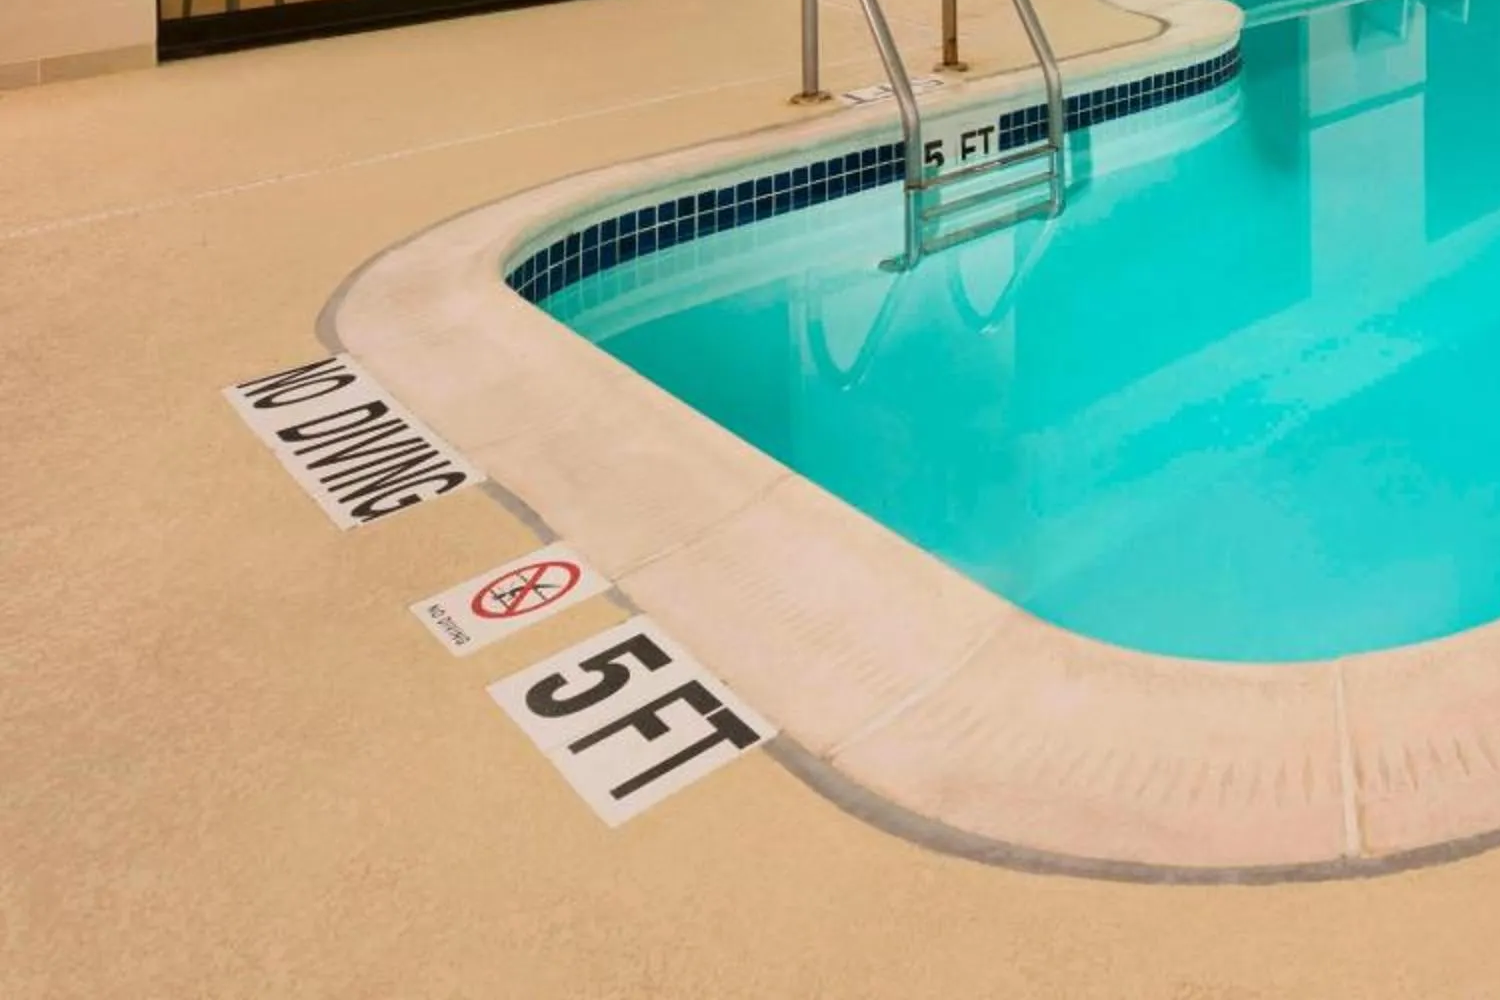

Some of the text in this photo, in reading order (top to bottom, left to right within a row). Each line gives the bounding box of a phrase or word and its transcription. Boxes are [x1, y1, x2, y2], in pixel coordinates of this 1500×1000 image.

[924, 125, 995, 169] 5 FT
[236, 357, 467, 523] NO DIVING
[525, 633, 761, 800] 5 FT
